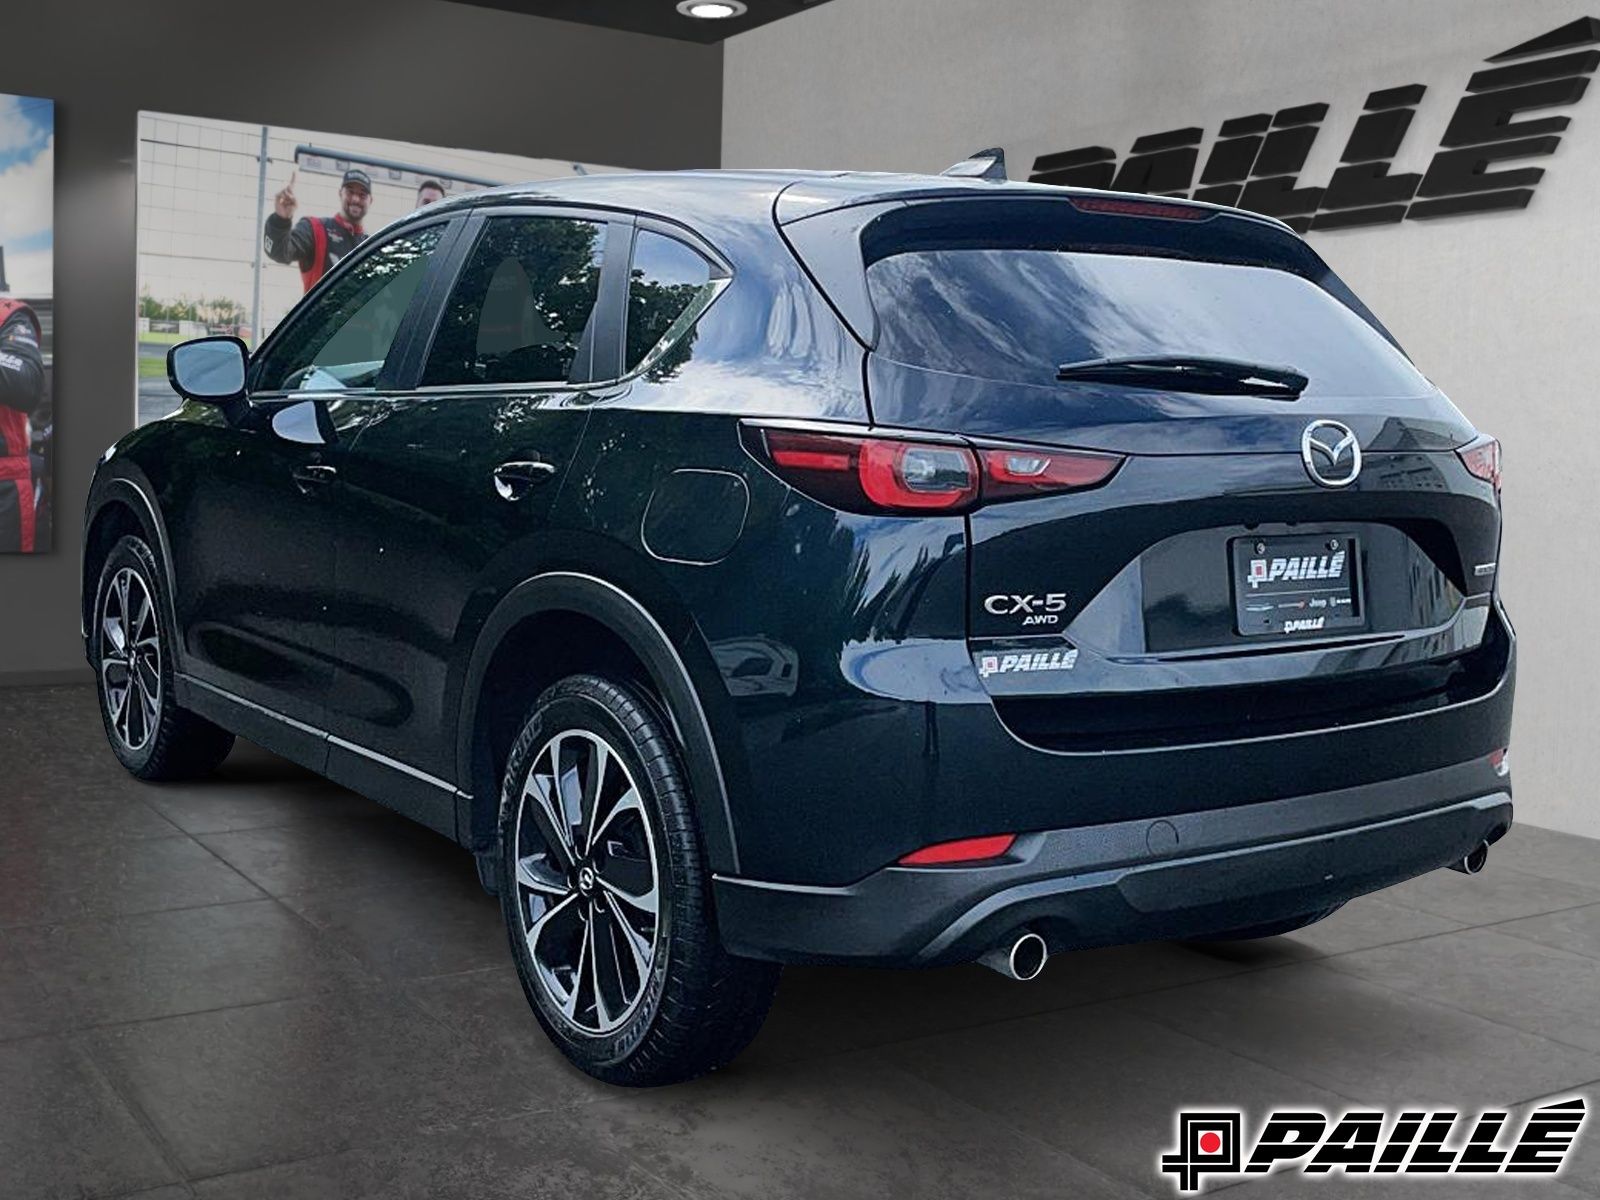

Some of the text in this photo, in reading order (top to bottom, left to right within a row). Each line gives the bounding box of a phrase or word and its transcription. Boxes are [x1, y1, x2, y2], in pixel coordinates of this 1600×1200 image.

[1268, 551, 1345, 581] PAILLÉ
[984, 593, 1067, 615] CX-5
[1022, 615, 1059, 626] AWD
